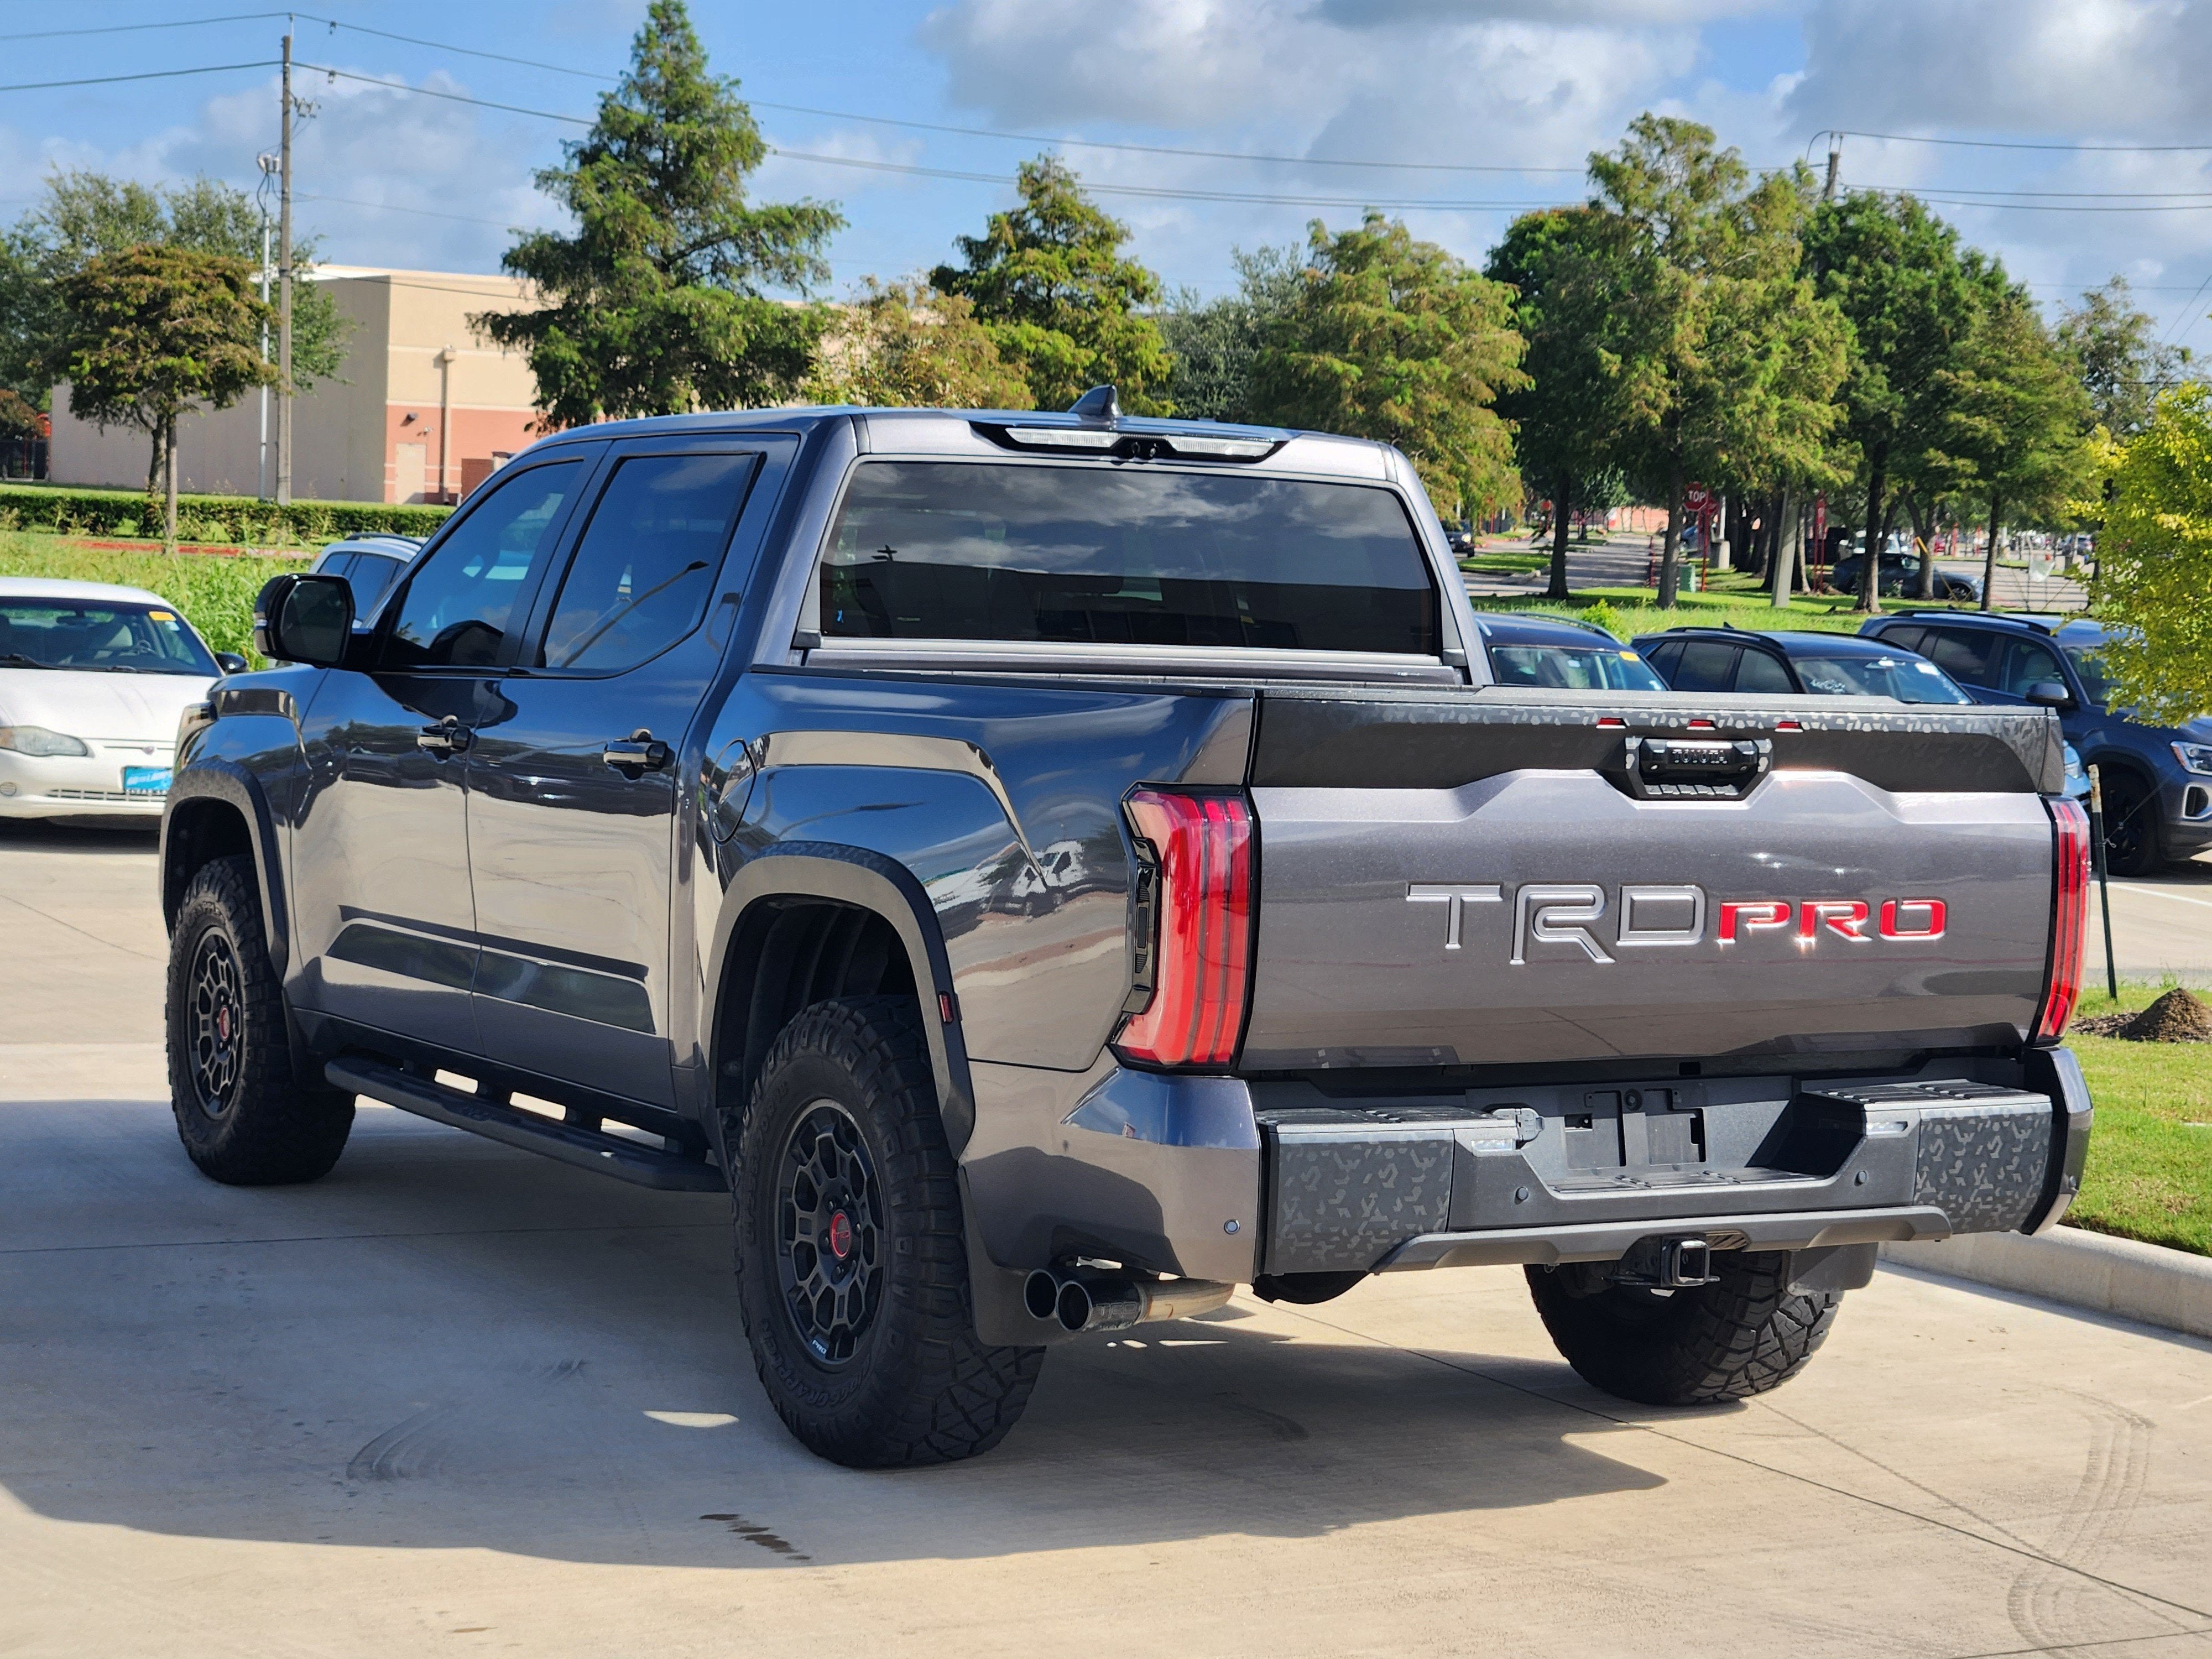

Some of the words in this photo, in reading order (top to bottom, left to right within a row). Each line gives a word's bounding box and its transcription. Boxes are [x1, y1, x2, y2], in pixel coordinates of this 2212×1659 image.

[1687, 490, 1706, 502] TOP
[1672, 748, 1728, 764] TOYOTA
[1406, 883, 1709, 965] TRD
[1717, 896, 1947, 946] PRO
[1096, 1301, 1138, 1319] TRD
[812, 1339, 827, 1355] PRO
